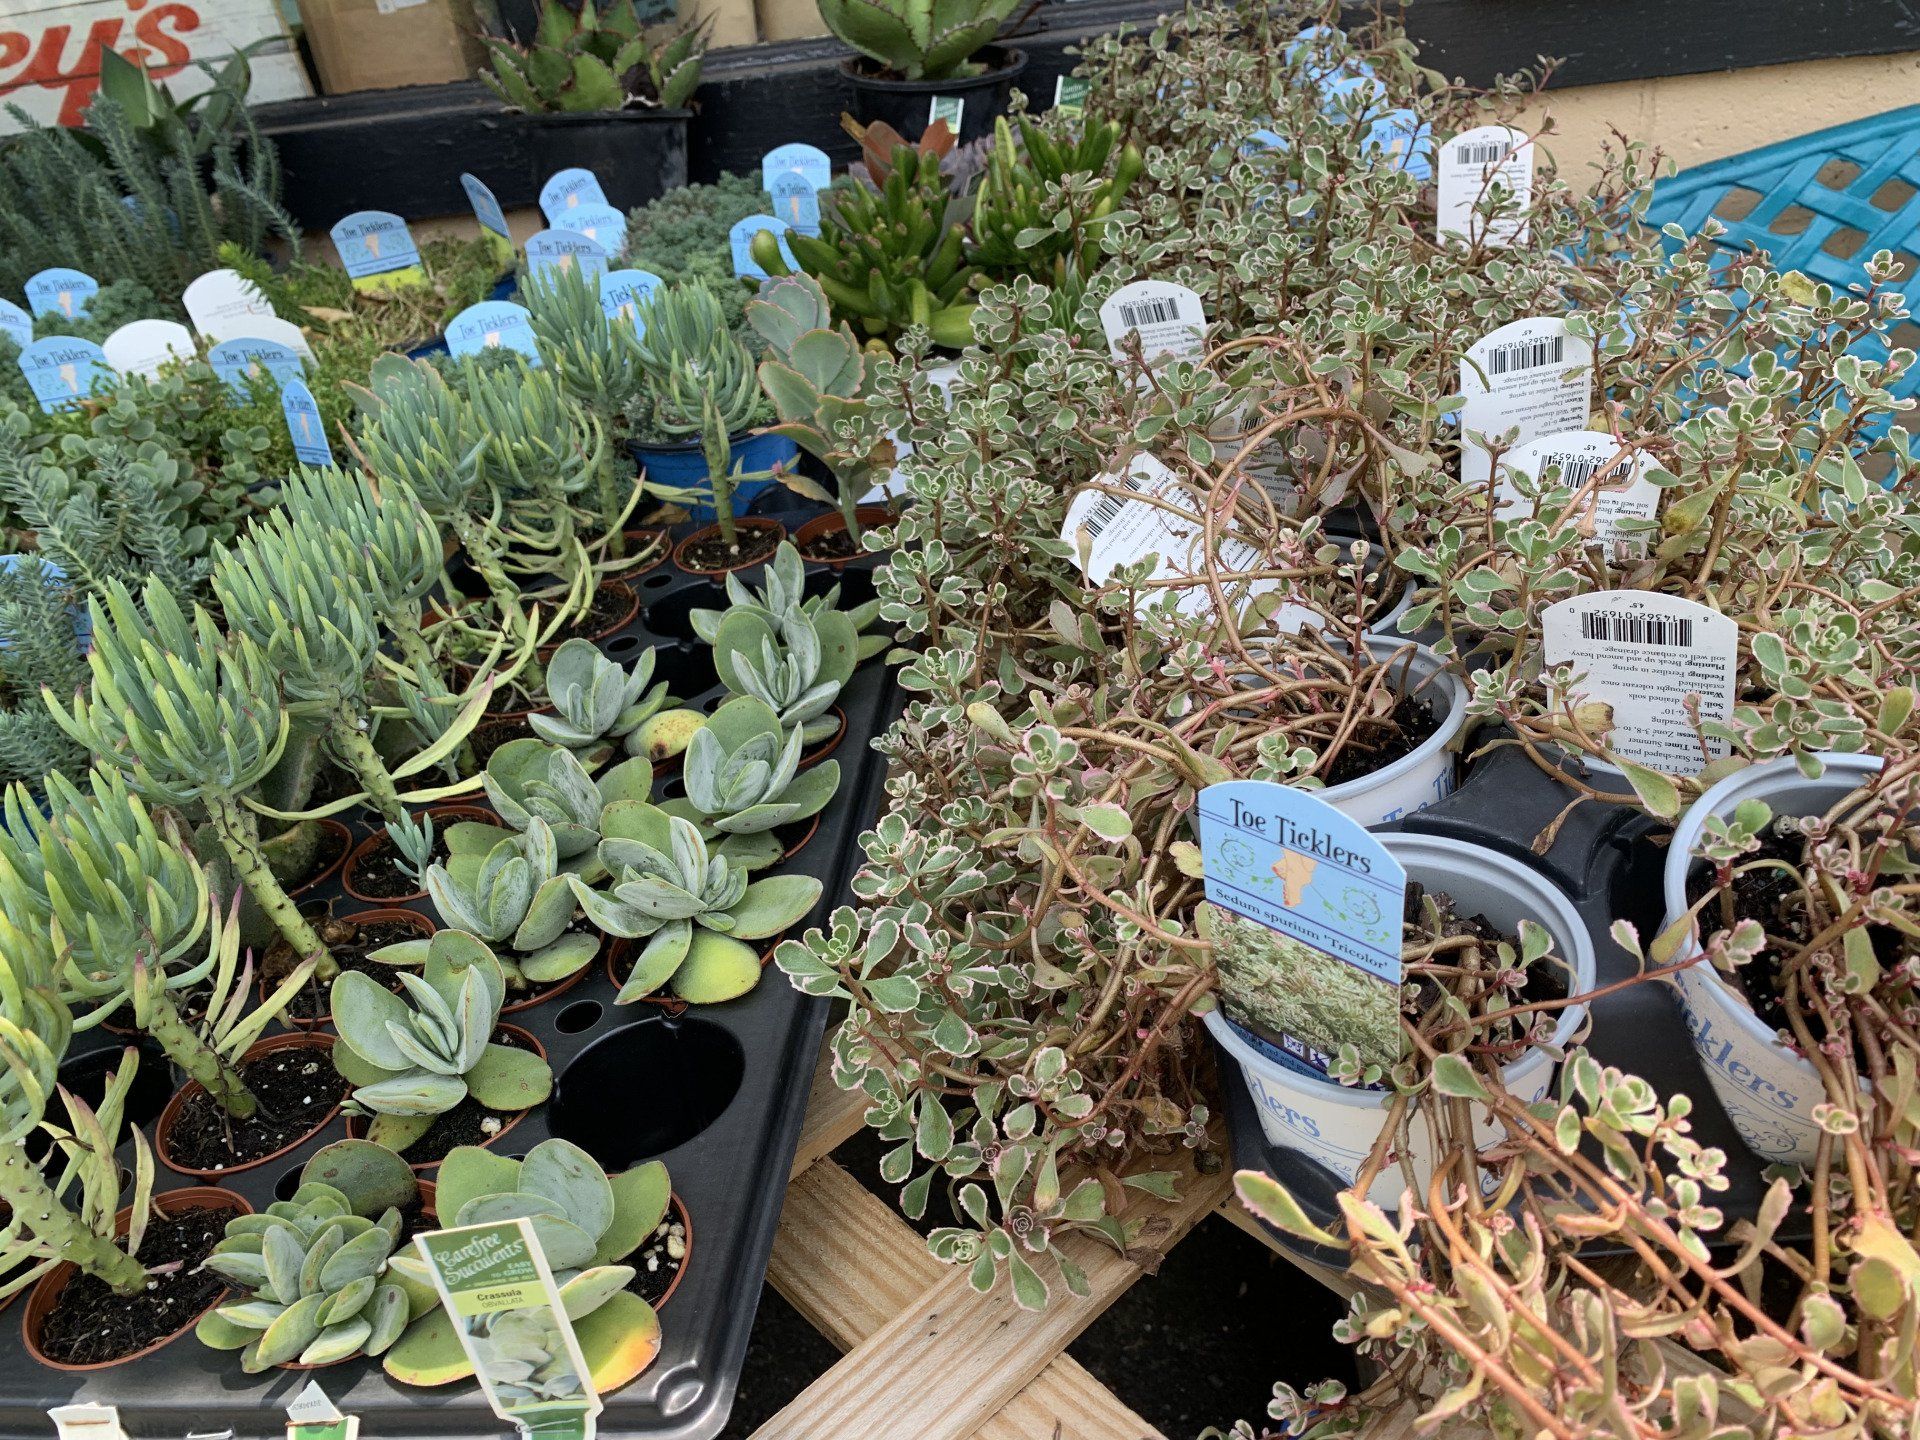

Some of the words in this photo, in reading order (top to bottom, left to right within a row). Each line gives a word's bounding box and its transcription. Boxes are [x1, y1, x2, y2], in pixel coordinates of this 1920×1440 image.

[478, 313, 518, 334] Ticklers
[1528, 334, 1554, 346] 14362
[1497, 341, 1524, 351] 01652
[50, 348, 91, 364] Ticklers
[1552, 451, 1585, 462] 01652
[1588, 455, 1609, 465] 362
[1593, 609, 1633, 620] 01652
[1638, 612, 1678, 623] 14362
[1601, 646, 1640, 656] drainage.
[1641, 650, 1677, 659] enhance
[1596, 653, 1625, 662] amend
[1626, 656, 1643, 664] and
[1658, 658, 1682, 667] Break
[1710, 655, 1726, 663] soil
[1684, 660, 1726, 671] Planting:
[1651, 668, 1685, 679] Fertilize
[1687, 671, 1725, 682] Feeding:
[1622, 682, 1654, 692] tolerant
[1677, 679, 1725, 690] established
[1649, 695, 1680, 705] drained
[1704, 700, 1724, 710] Soil:
[1660, 708, 1685, 716] 6-10"
[1685, 709, 1724, 721] Spaci:
[1627, 737, 1663, 748] Summer
[1676, 731, 1722, 743] Hariness:
[1623, 747, 1642, 755] pink
[1664, 741, 1690, 751] Time:
[1690, 745, 1722, 754] Blom
[1643, 750, 1691, 762] Star-shaped
[1229, 798, 1266, 835] Toe
[1275, 814, 1371, 874] Ticklers
[1216, 887, 1260, 915] Sedum
[1263, 909, 1321, 941] spurium
[1323, 933, 1388, 969] 'Tricolor'
[434, 1233, 501, 1267] Carefree
[444, 1238, 524, 1285] Succulents
[477, 1289, 522, 1302] Crassula
[481, 1297, 526, 1309] OBVALLATA
